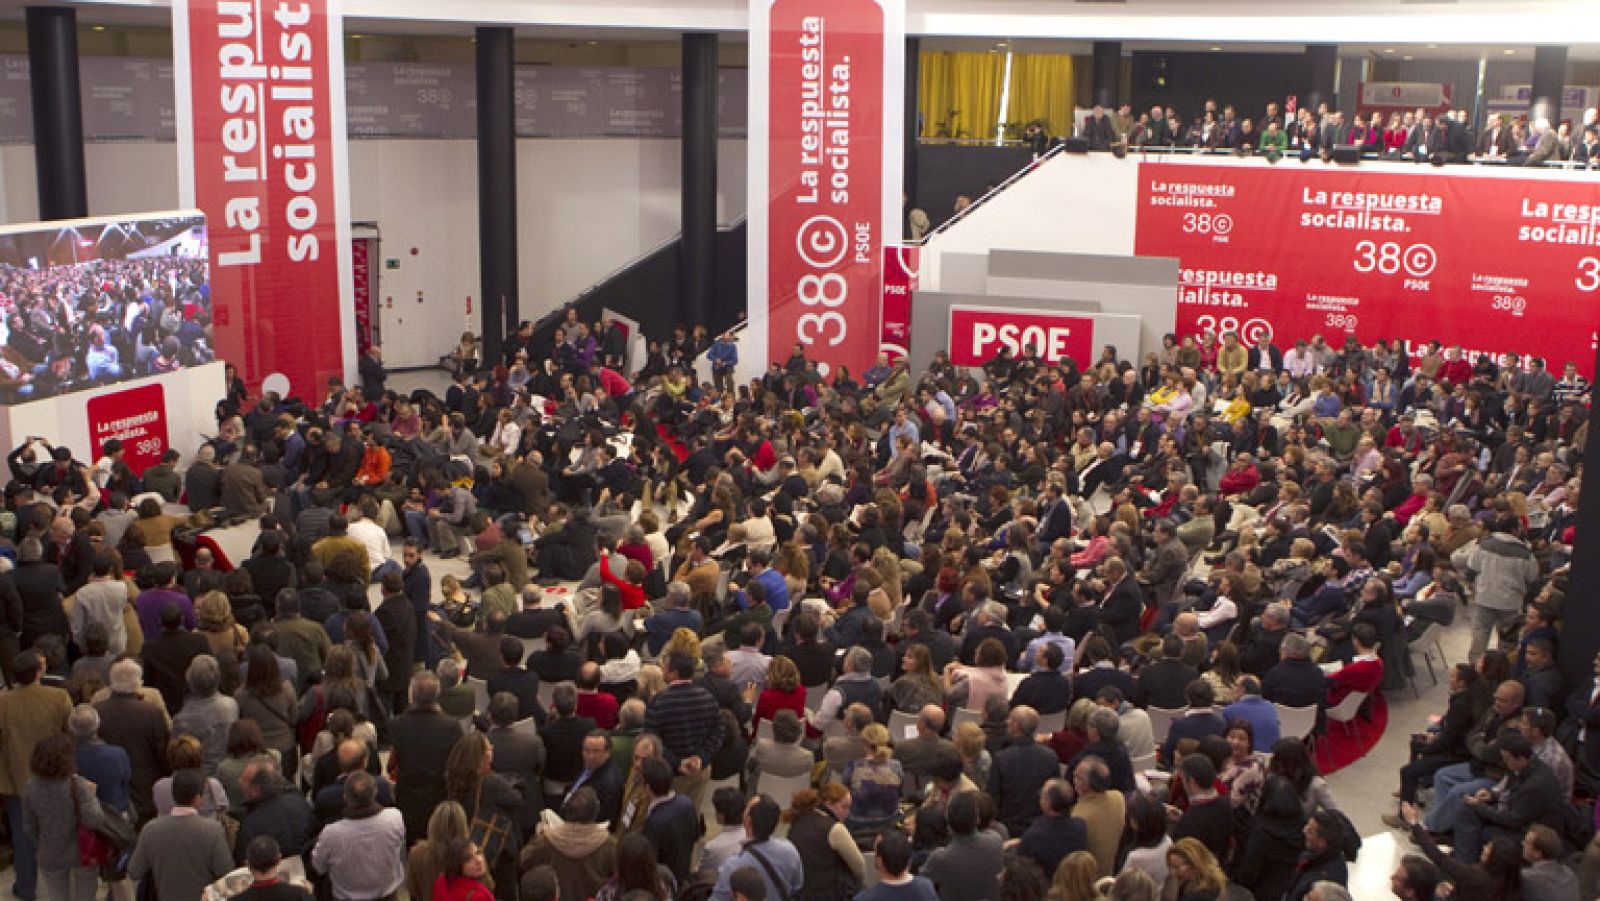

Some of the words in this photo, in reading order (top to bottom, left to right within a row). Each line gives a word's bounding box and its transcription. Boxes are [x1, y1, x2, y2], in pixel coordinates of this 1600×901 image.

[799, 16, 826, 165] respuesta
[826, 55, 850, 204] socialista.
[796, 170, 820, 204] La
[1151, 180, 1167, 193] La
[1168, 183, 1236, 197] respuesta
[1150, 195, 1217, 208] socialista.
[1303, 187, 1327, 205] La
[1331, 191, 1443, 215] respuesta
[1522, 197, 1549, 218] La
[218, 197, 261, 267] La
[1300, 210, 1412, 232] socialista.
[855, 222, 870, 264] PSOE
[1403, 278, 1431, 292] PSOE
[972, 321, 1071, 362] PSOE
[1404, 339, 1427, 358] La
[97, 421, 109, 434] La
